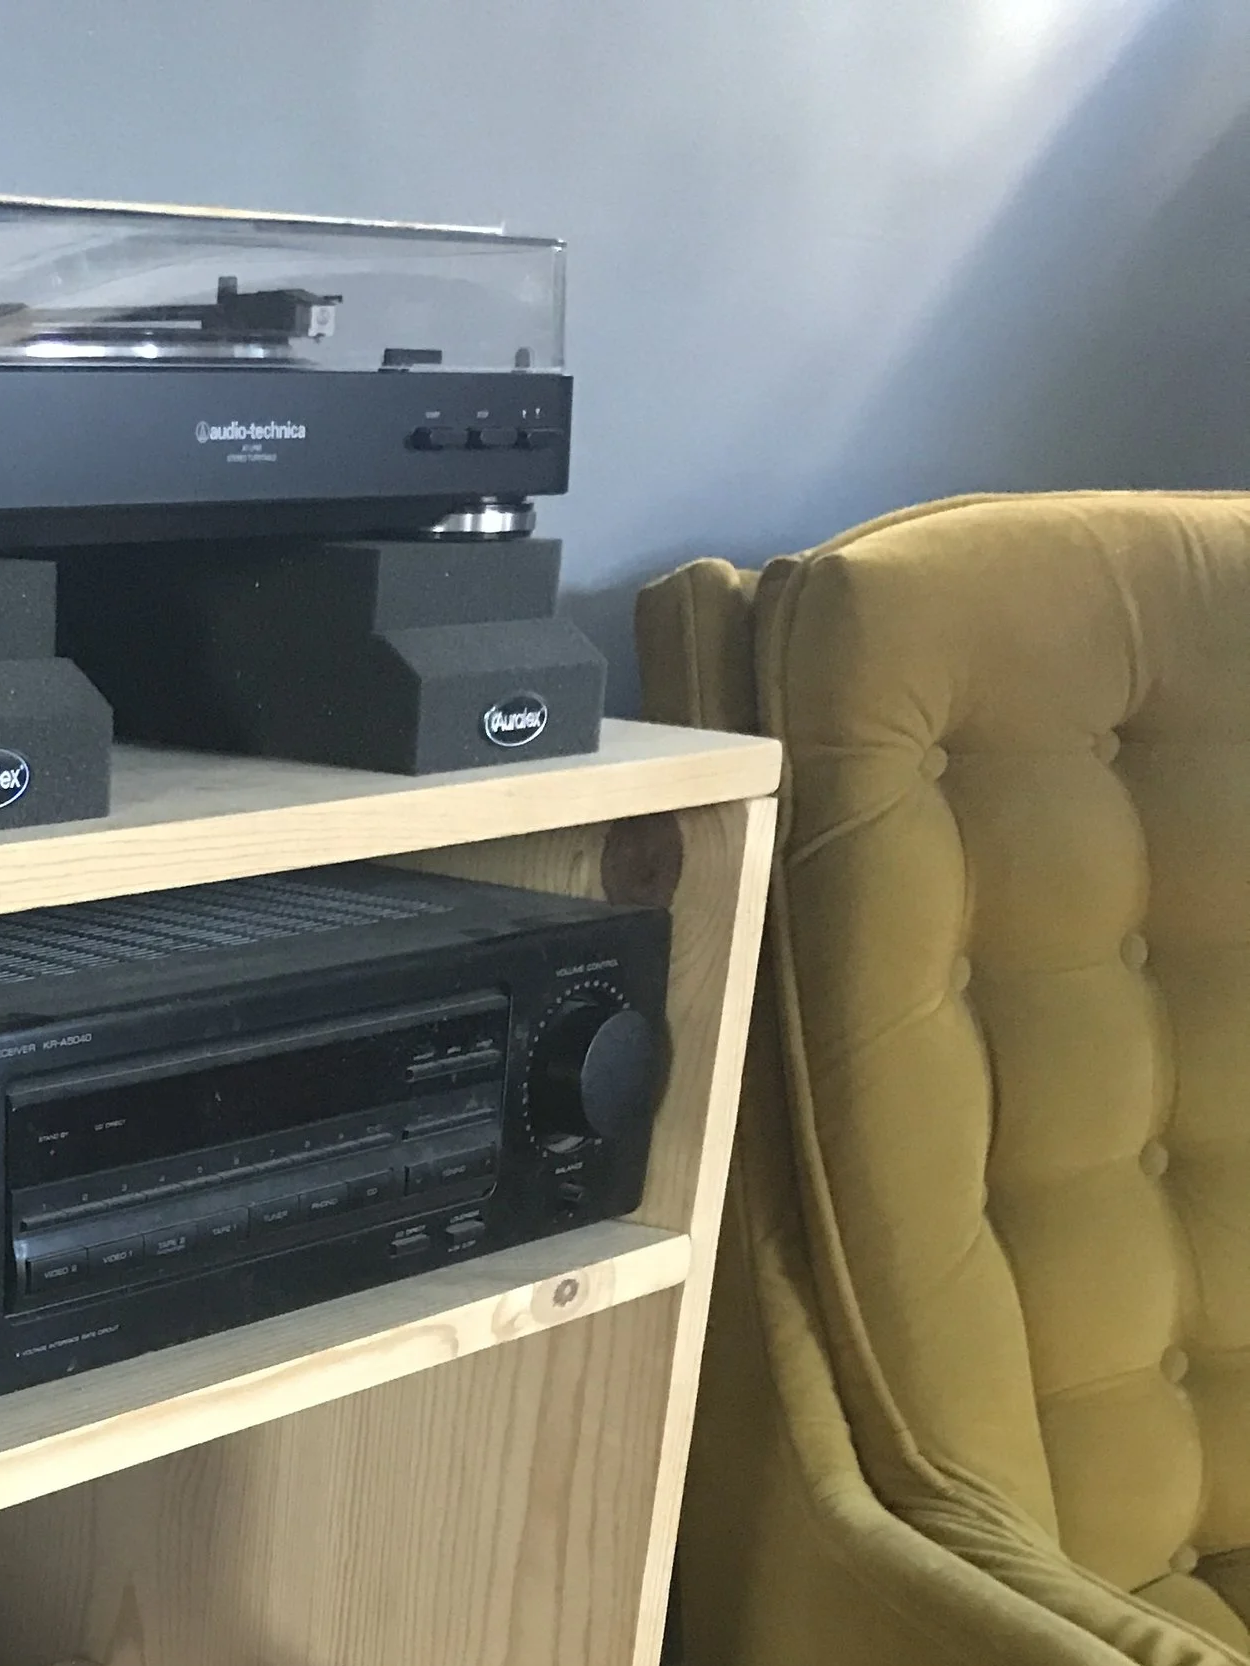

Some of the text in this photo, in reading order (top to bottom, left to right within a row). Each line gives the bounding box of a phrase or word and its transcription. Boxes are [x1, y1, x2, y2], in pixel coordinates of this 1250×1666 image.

[209, 420, 306, 441] audio-technica
[492, 706, 542, 733] Auralex
[102, 1251, 128, 1265] VIDEO
[43, 1266, 70, 1279] VIDEO
